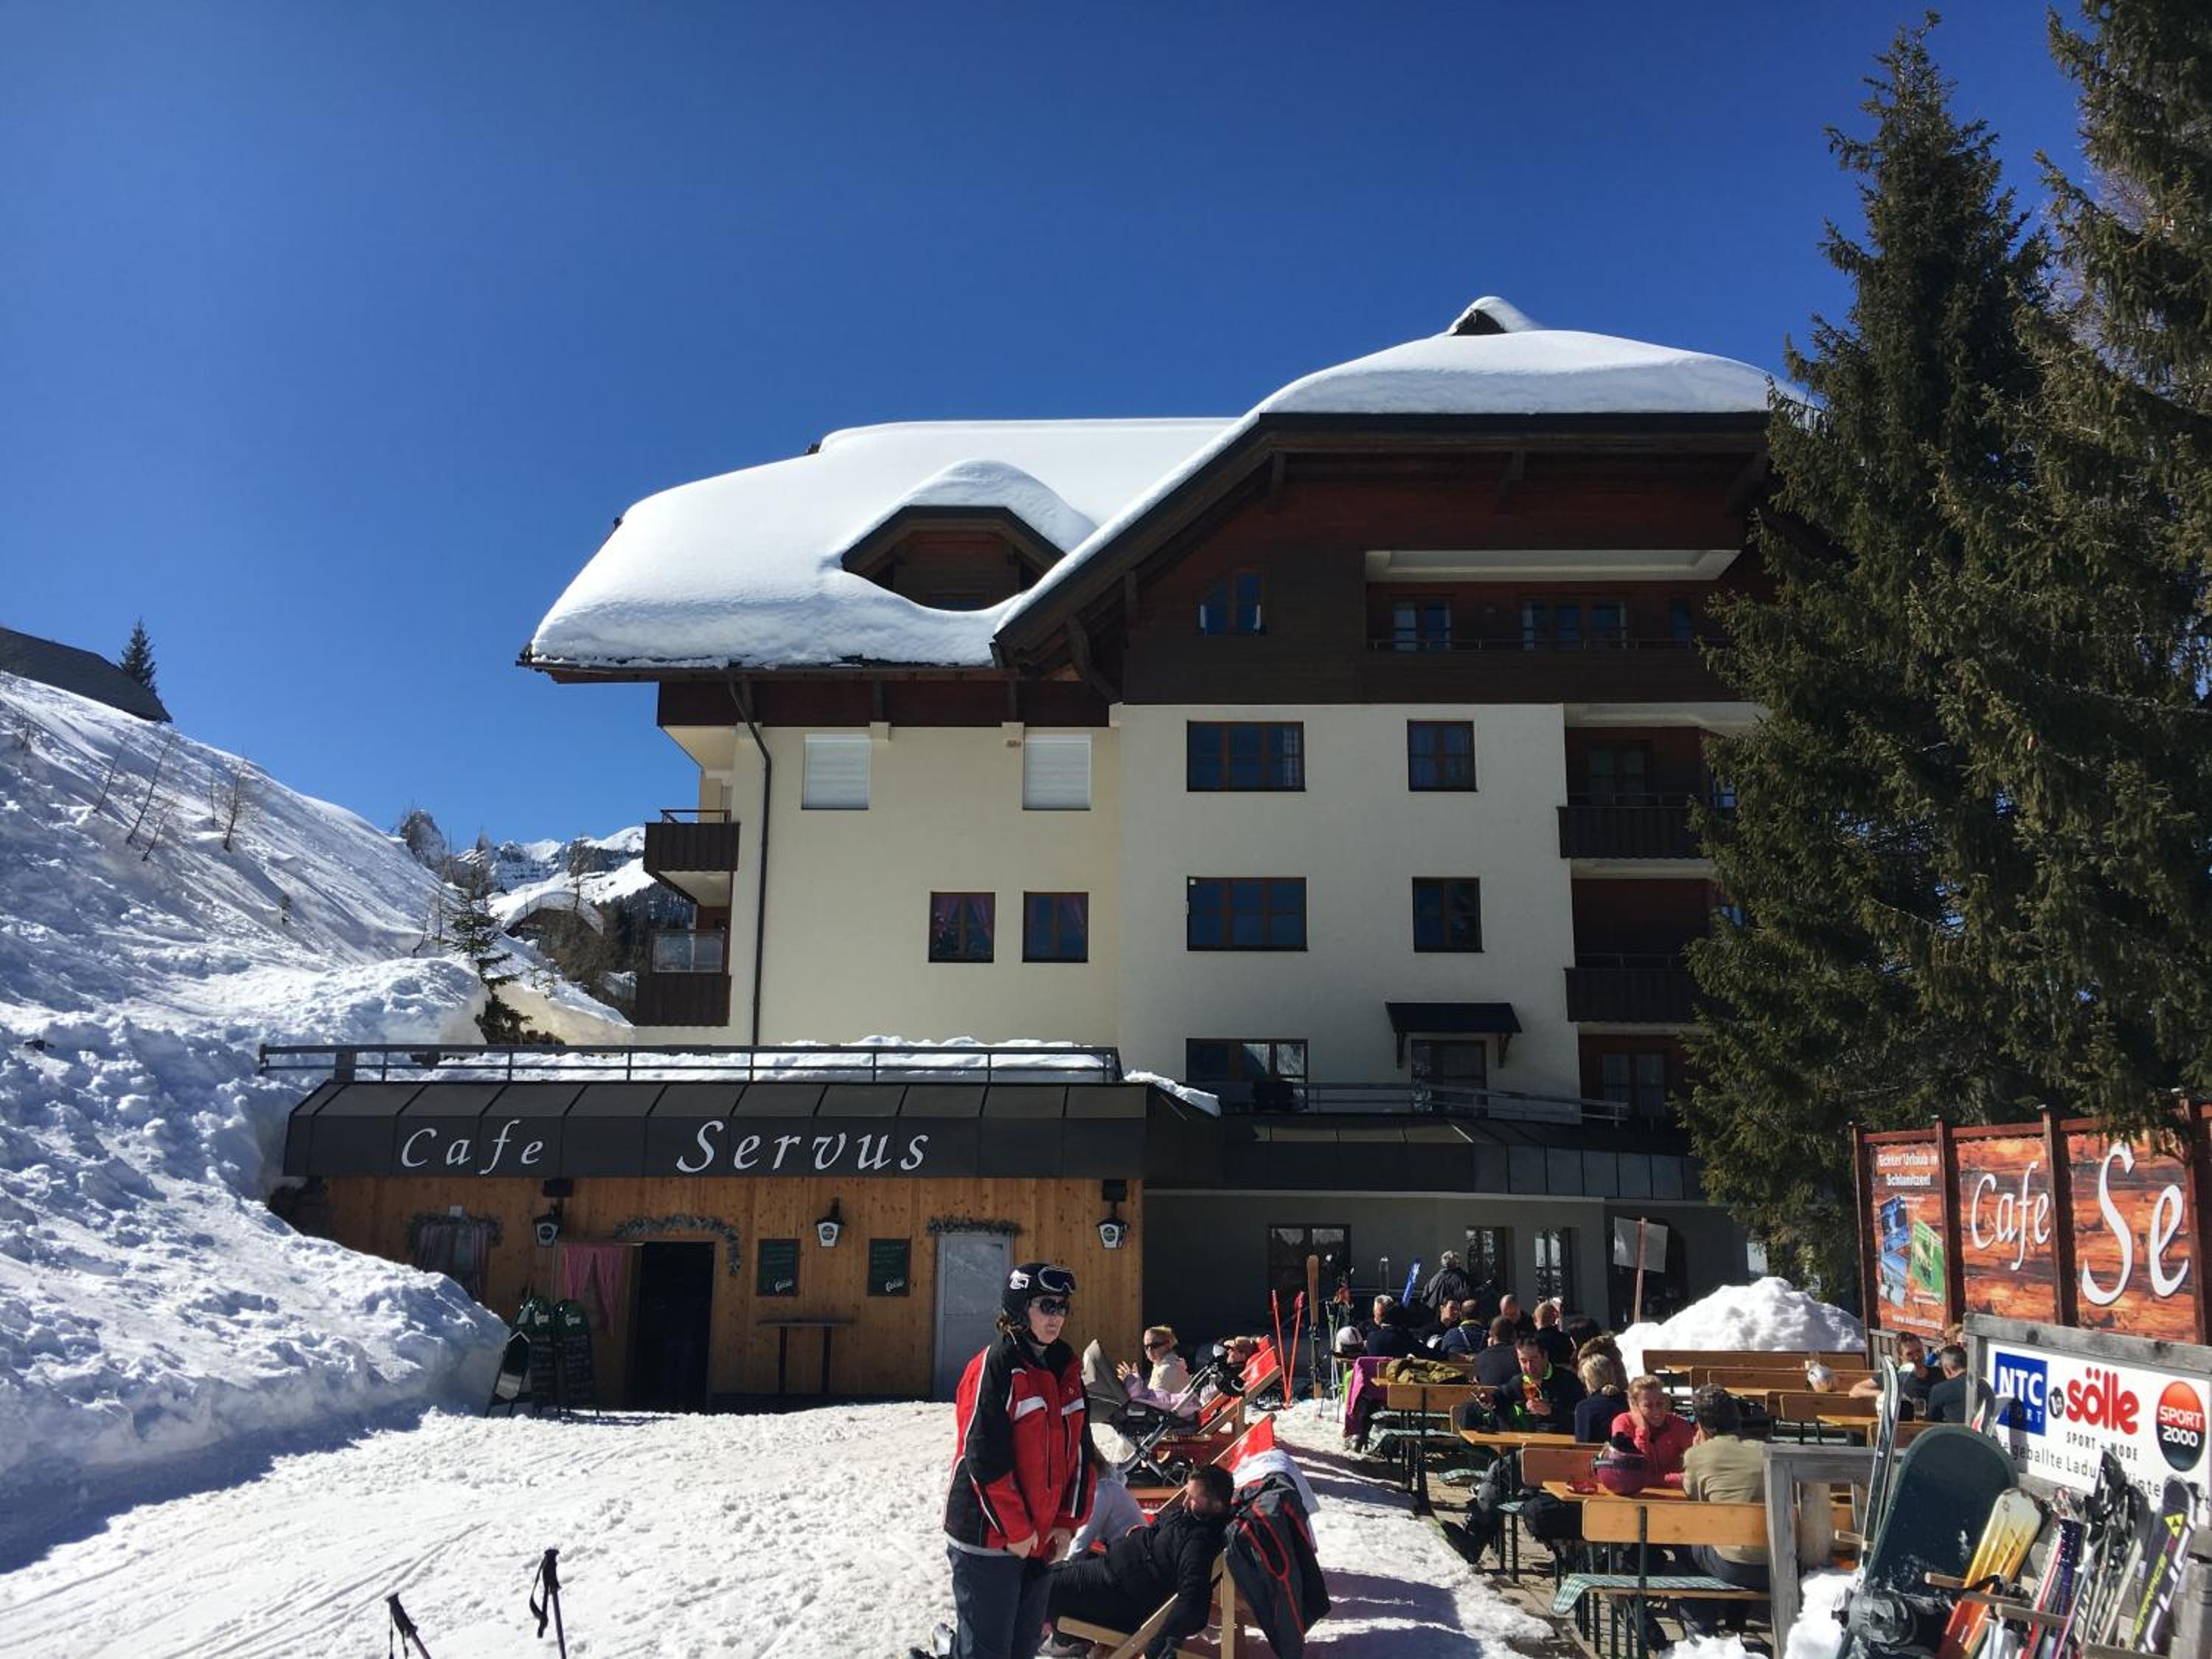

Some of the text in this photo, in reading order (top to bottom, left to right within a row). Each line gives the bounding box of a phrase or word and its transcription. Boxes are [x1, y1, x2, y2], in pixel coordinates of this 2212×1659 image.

[400, 1120, 930, 1175] Cafe Servus
[1970, 1160, 2051, 1270] Cafe
[1999, 1366, 2044, 1407] NTC
[2066, 1366, 2140, 1435] sölle
[2159, 1405, 2202, 1428] SPORT
[2066, 1431, 2096, 1450] SPORT
[2110, 1442, 2138, 1462] MODE
[2163, 1425, 2198, 1447] 2000
[2067, 1455, 2096, 1479] Ladu
